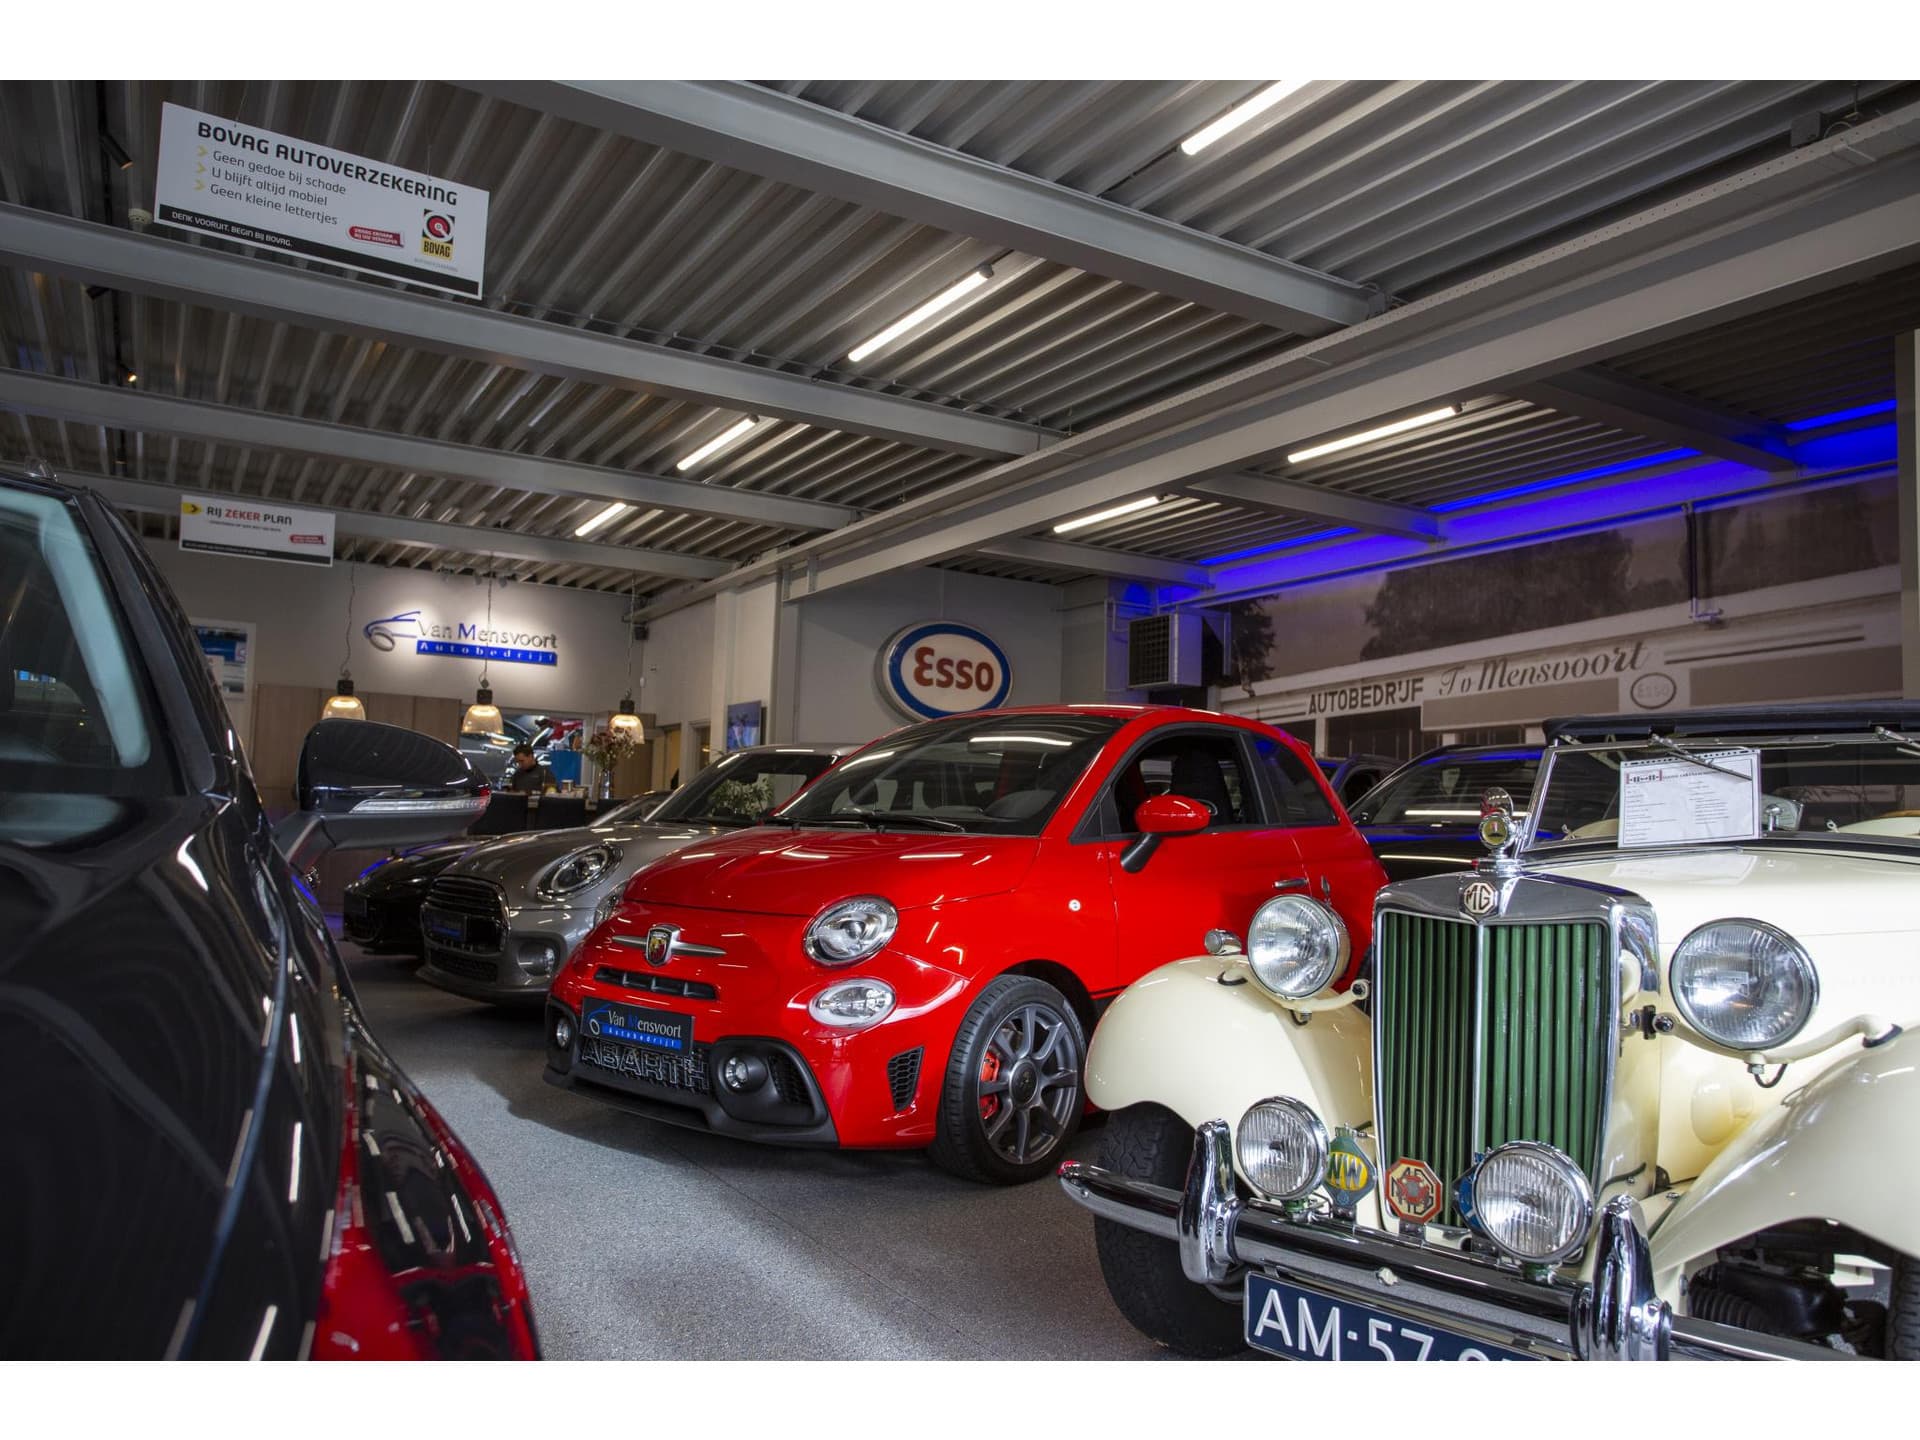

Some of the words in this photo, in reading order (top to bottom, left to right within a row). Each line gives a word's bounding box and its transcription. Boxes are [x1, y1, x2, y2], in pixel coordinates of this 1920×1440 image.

[198, 122, 269, 155] BOVAG
[275, 144, 458, 206] AUTOVERZEKERING
[213, 150, 245, 168] Geen
[248, 161, 285, 177] gedoe
[288, 170, 303, 185] bij
[305, 176, 346, 195] schade
[211, 167, 220, 178] U
[224, 170, 253, 186] blijft
[256, 180, 286, 195] altijd
[288, 188, 328, 206] mobiel
[210, 183, 242, 201] Geen
[246, 192, 281, 211] kleine
[285, 202, 338, 225] lettertjes
[171, 211, 194, 223] DENK
[231, 226, 254, 238] BEGIN
[423, 241, 451, 258] BOVAG
[206, 506, 223, 519] RIJ
[224, 508, 261, 521] ZEKER
[263, 513, 292, 526] PLAN
[416, 620, 452, 638] Van
[457, 622, 559, 649] Mensvoort
[1478, 641, 1647, 692] Mensvoort
[1466, 884, 1491, 910] MG
[608, 1010, 625, 1027] Van
[582, 1038, 711, 1090] ABARTH
